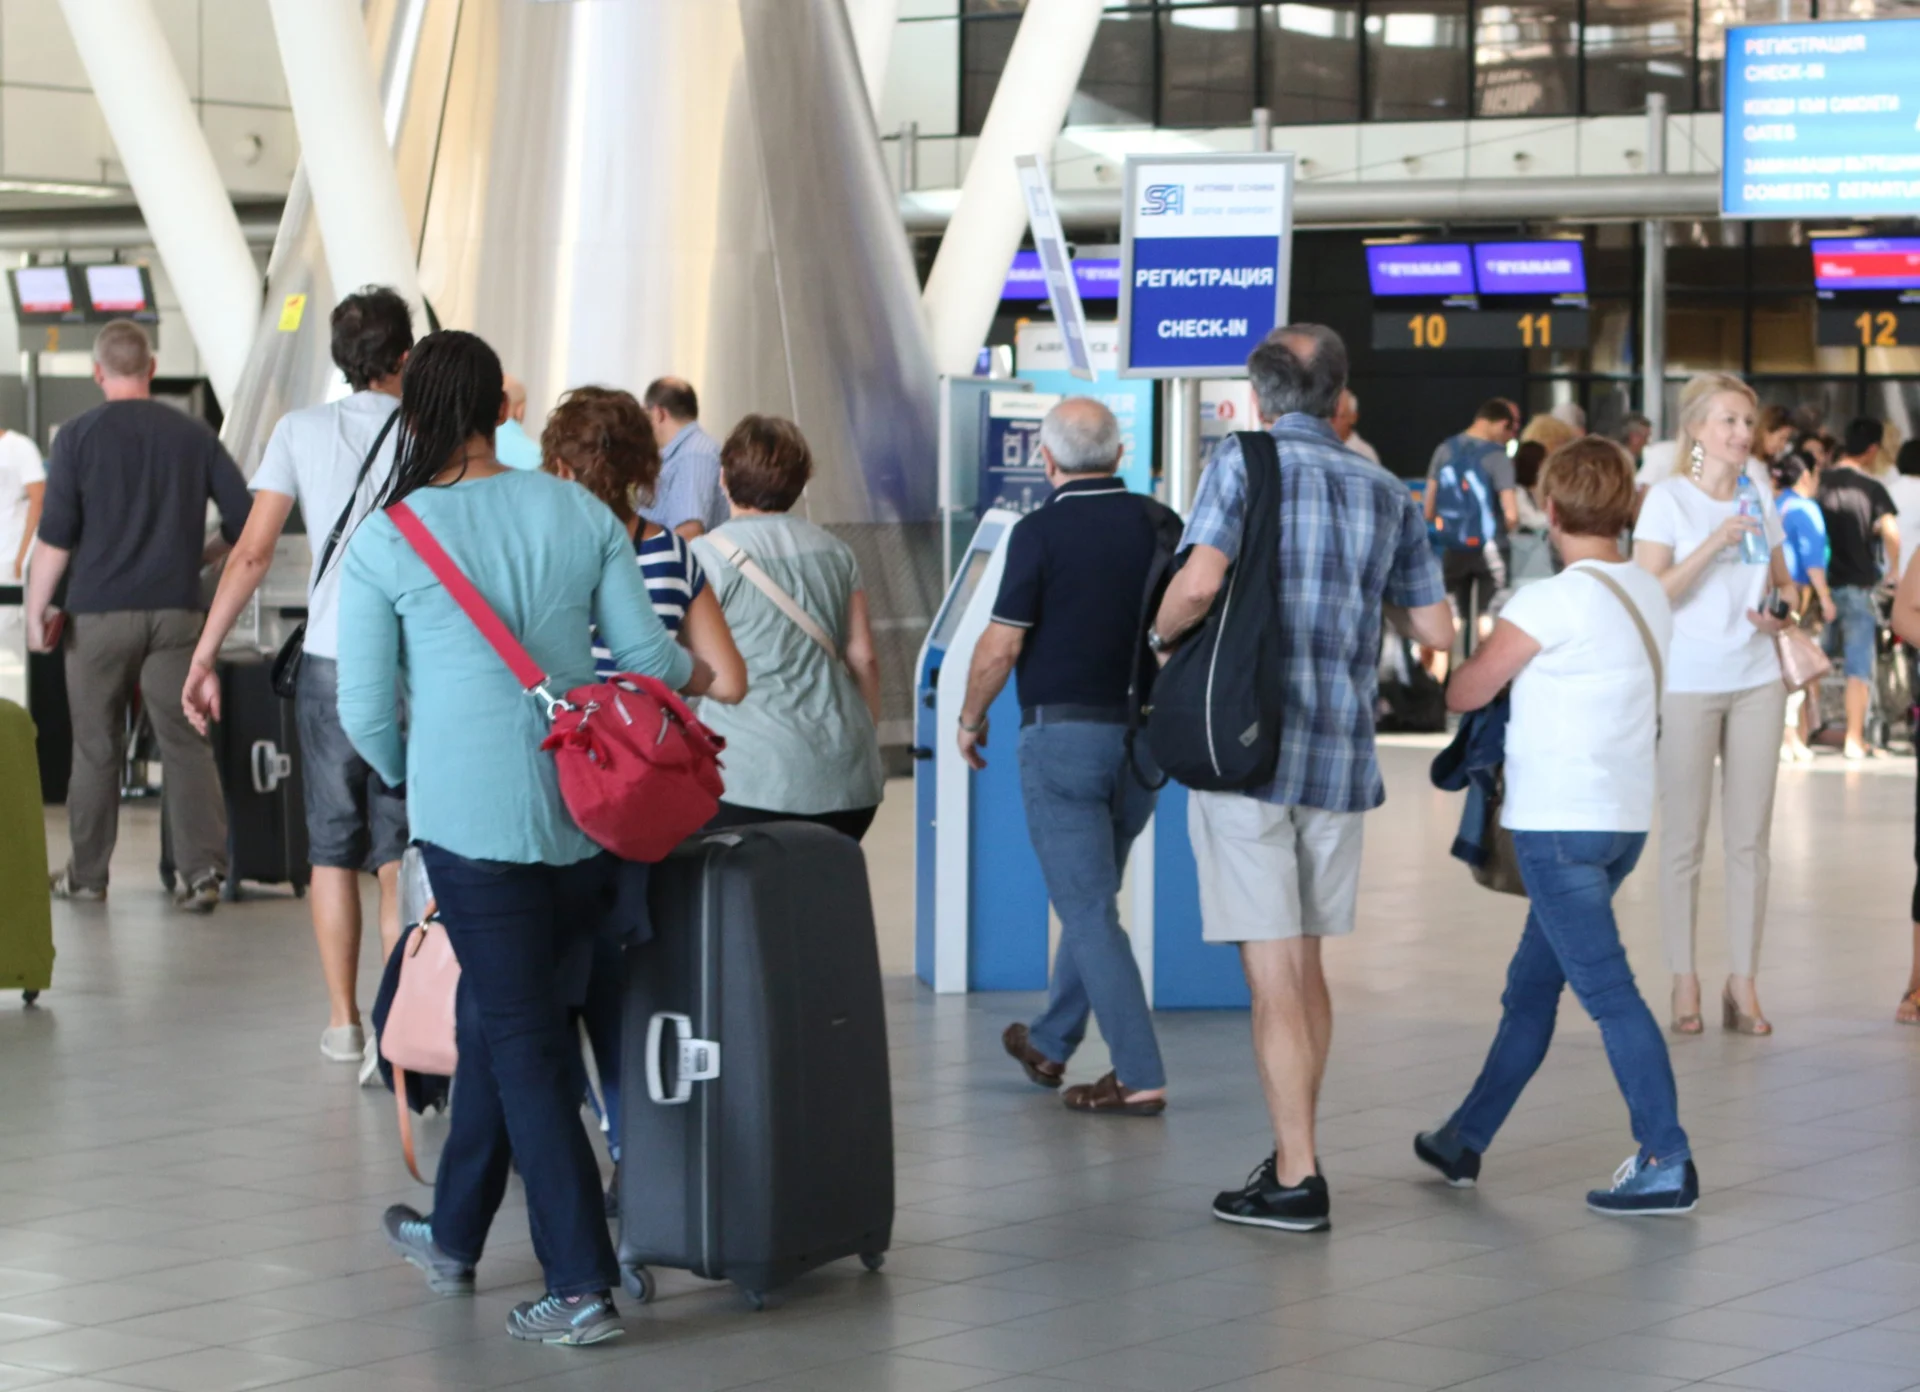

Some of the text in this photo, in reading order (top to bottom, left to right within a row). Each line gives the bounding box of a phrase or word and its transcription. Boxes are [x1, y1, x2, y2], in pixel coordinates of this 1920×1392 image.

[1746, 34, 1866, 55] РЕГИСТРАЦИЯ
[1745, 65, 1825, 81] CHECK-IN
[1744, 183, 1830, 200] DOMESTIC
[1135, 267, 1274, 290] РЕГИСТРАЦИЯ
[1157, 318, 1248, 339] CHECK-IN
[1408, 313, 1448, 348] 10
[1516, 313, 1552, 348] 11
[1855, 311, 1898, 347] 12
